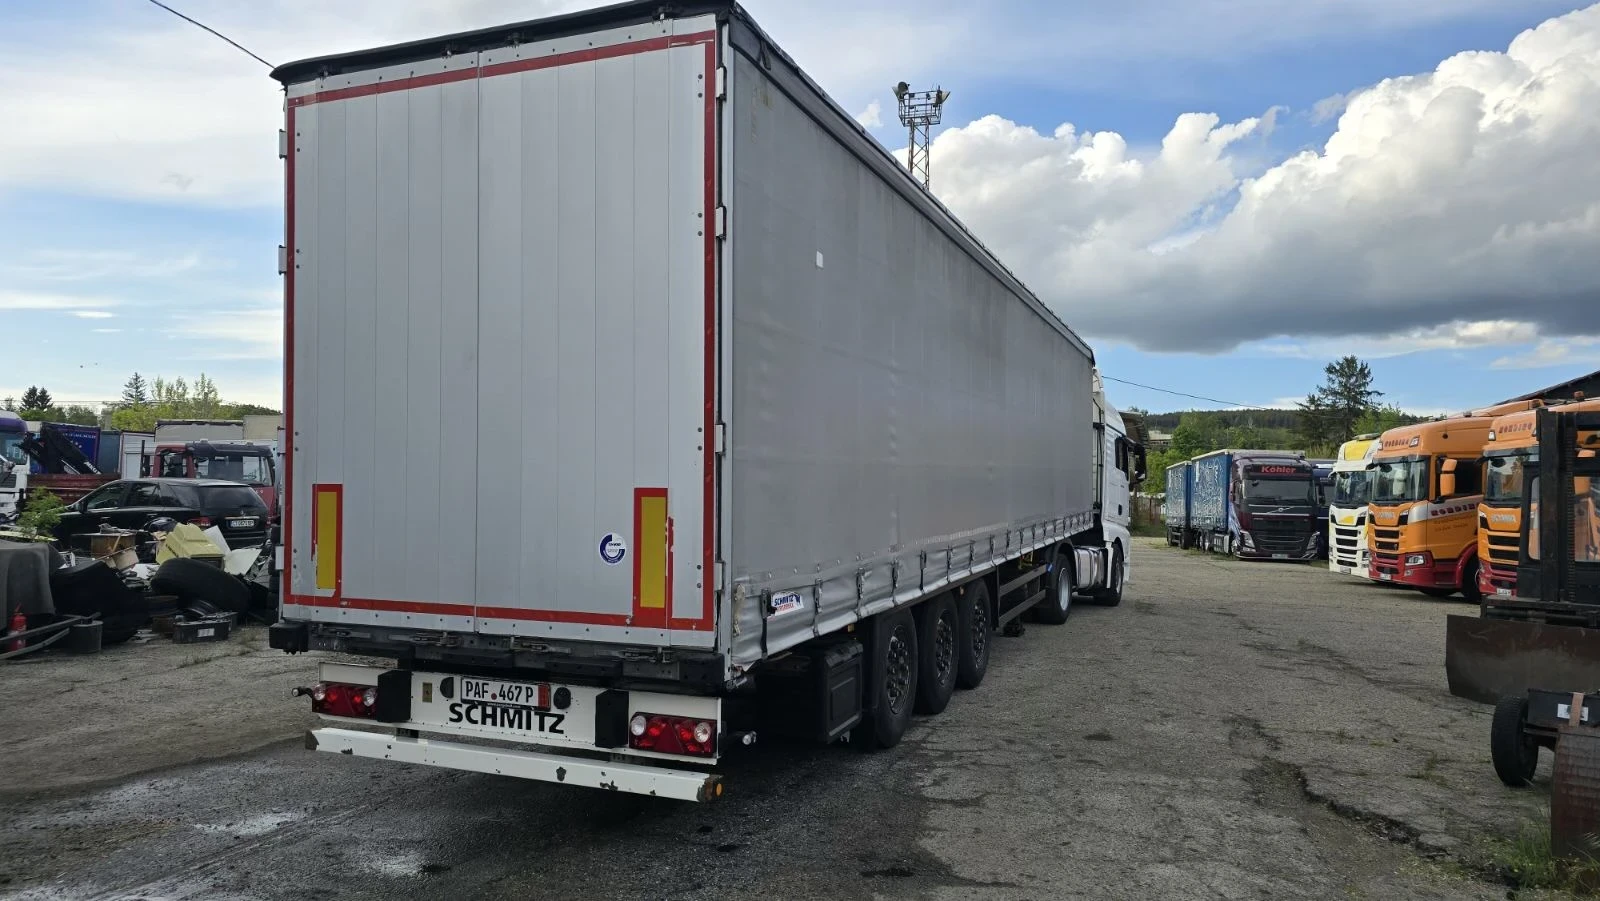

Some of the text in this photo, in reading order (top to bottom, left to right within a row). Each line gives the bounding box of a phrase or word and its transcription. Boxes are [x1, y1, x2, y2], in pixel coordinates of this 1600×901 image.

[465, 681, 534, 703] PAF 467 P
[449, 702, 565, 734] SCHMITZ
